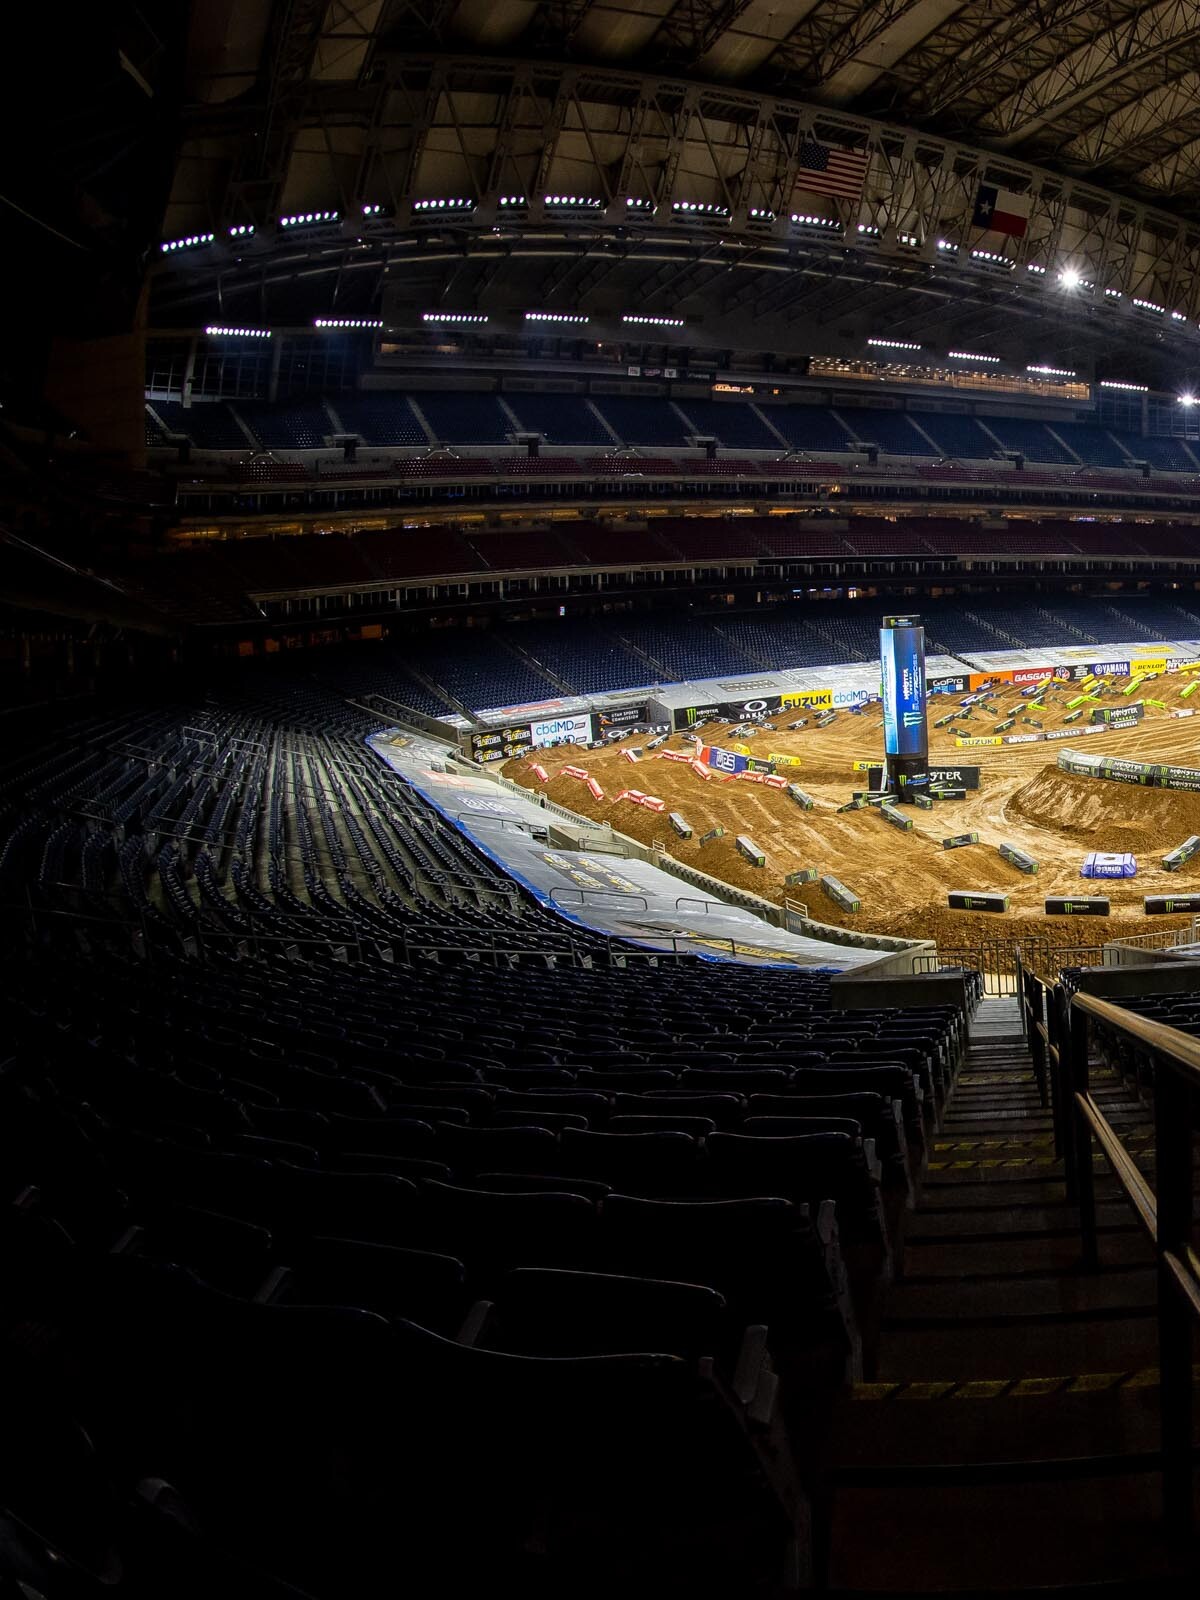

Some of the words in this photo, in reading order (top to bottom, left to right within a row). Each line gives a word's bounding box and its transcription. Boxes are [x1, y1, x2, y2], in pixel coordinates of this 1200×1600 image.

[1102, 663, 1128, 673] YAMAHA
[933, 678, 963, 686] GoPro
[1015, 672, 1052, 682] GASGAS
[784, 694, 831, 709] SUZUKI
[834, 689, 868, 704] cbdMD
[1111, 707, 1138, 718] MONSTER
[536, 720, 574, 736] cbdMD
[770, 754, 793, 764] SUZUKI
[1114, 761, 1142, 771] MONSTER
[1112, 771, 1139, 780] MONSTER
[1169, 779, 1200, 788] MONSTER
